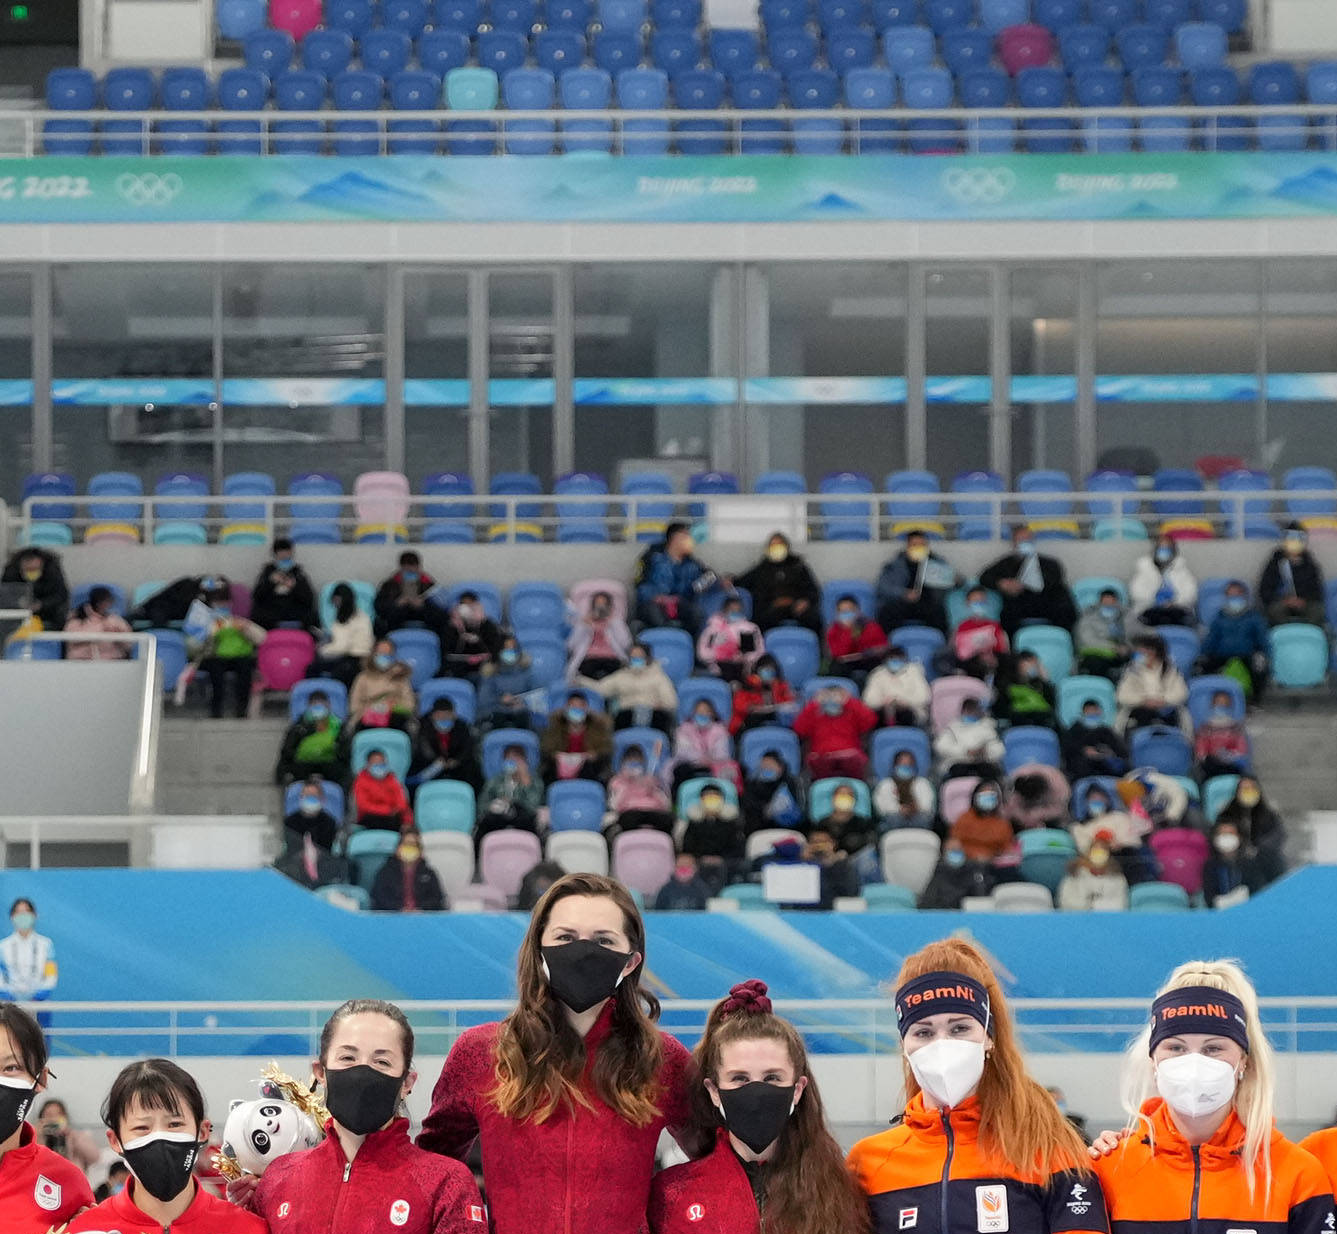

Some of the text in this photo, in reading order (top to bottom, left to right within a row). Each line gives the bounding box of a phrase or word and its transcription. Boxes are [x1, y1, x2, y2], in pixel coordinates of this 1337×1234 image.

[22, 175, 93, 198] 2022
[904, 985, 976, 1008] TeamNL
[1162, 1003, 1228, 1020] TeamNL
